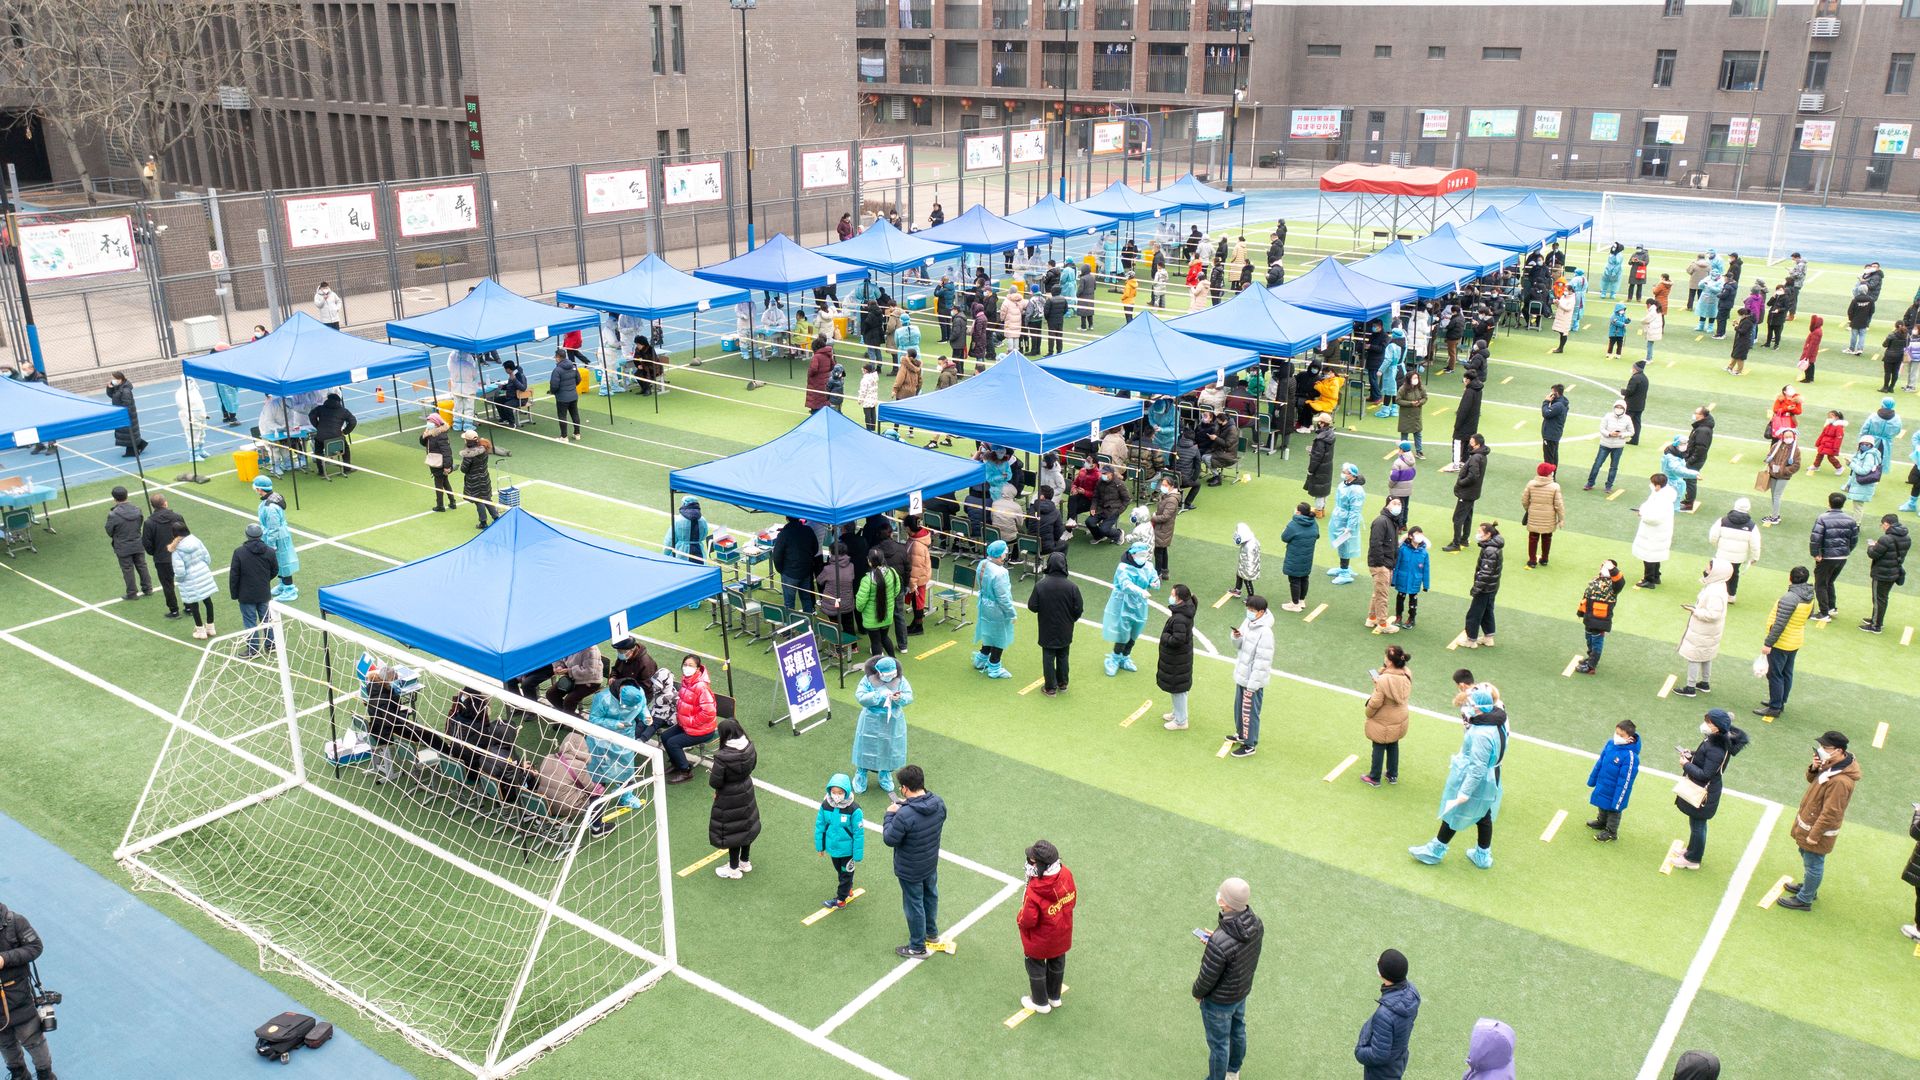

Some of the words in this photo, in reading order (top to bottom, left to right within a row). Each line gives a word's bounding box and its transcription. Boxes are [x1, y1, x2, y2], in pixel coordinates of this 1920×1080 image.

[348, 207, 370, 231] 自由
[101, 234, 130, 258] 和谐
[912, 497, 920, 510] 2
[615, 621, 622, 636] 1
[783, 645, 817, 678] 采集区
